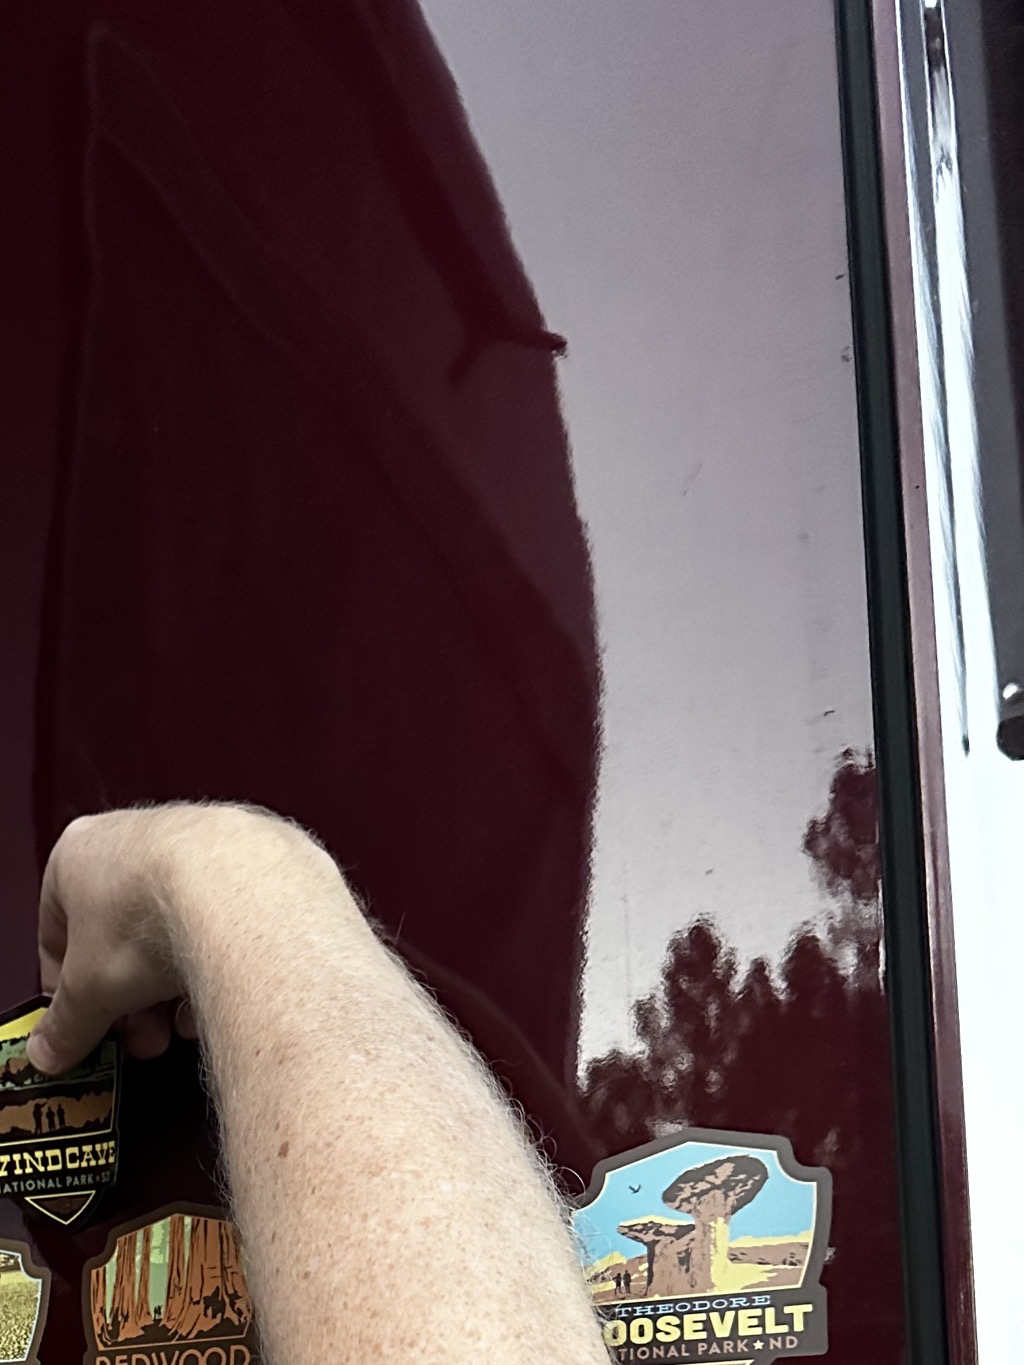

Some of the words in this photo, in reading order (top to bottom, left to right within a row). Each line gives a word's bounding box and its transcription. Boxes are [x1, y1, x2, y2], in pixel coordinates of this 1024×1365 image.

[66, 1141, 116, 1169] CAVE
[66, 1174, 94, 1187] PARK
[615, 1295, 771, 1317] THEODORE
[602, 1304, 813, 1347] OOSEVELT
[619, 1344, 690, 1361] TIONAL
[698, 1339, 748, 1355] PARK
[769, 1335, 798, 1349] ND
